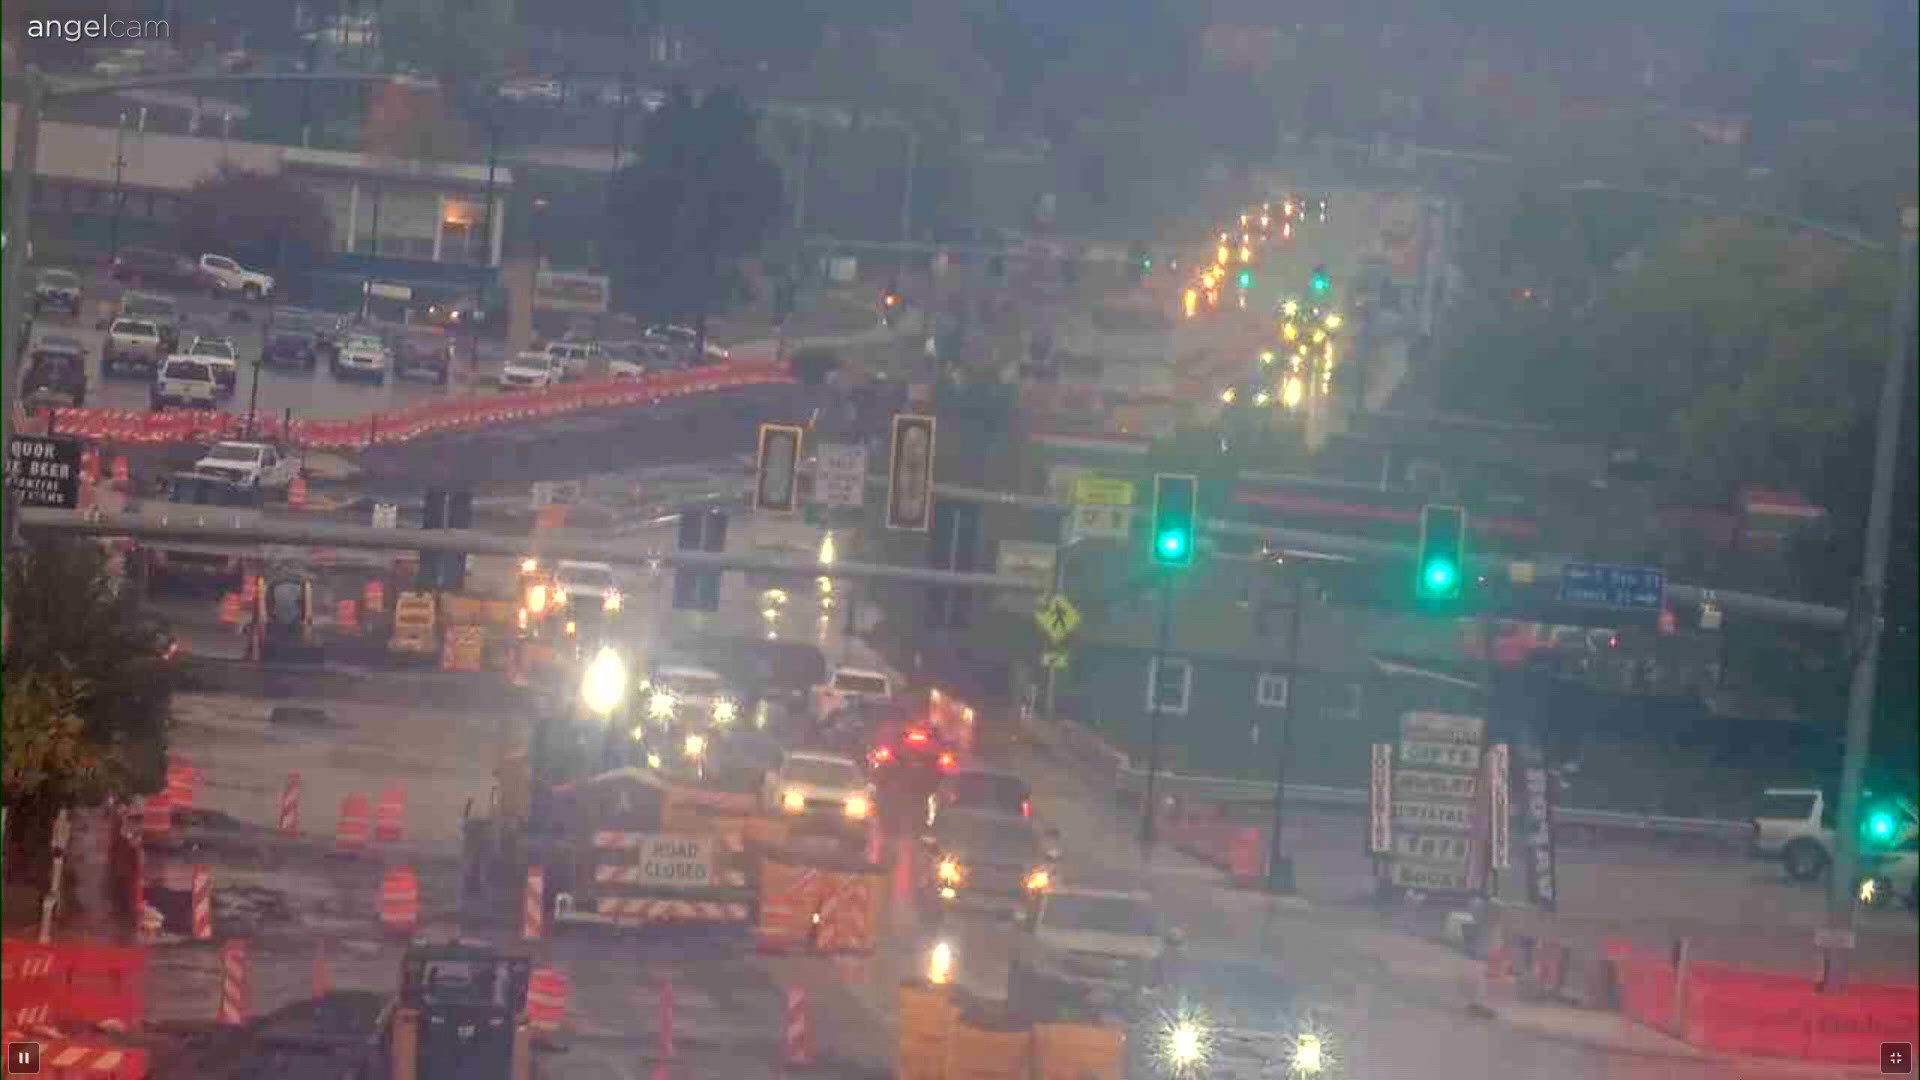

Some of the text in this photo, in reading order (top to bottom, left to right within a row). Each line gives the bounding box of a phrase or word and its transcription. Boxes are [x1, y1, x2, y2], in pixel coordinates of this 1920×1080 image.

[11, 441, 56, 458] QUOR
[30, 461, 70, 480] BEER
[653, 840, 699, 858] ROAD
[645, 861, 706, 879] CLOSED
